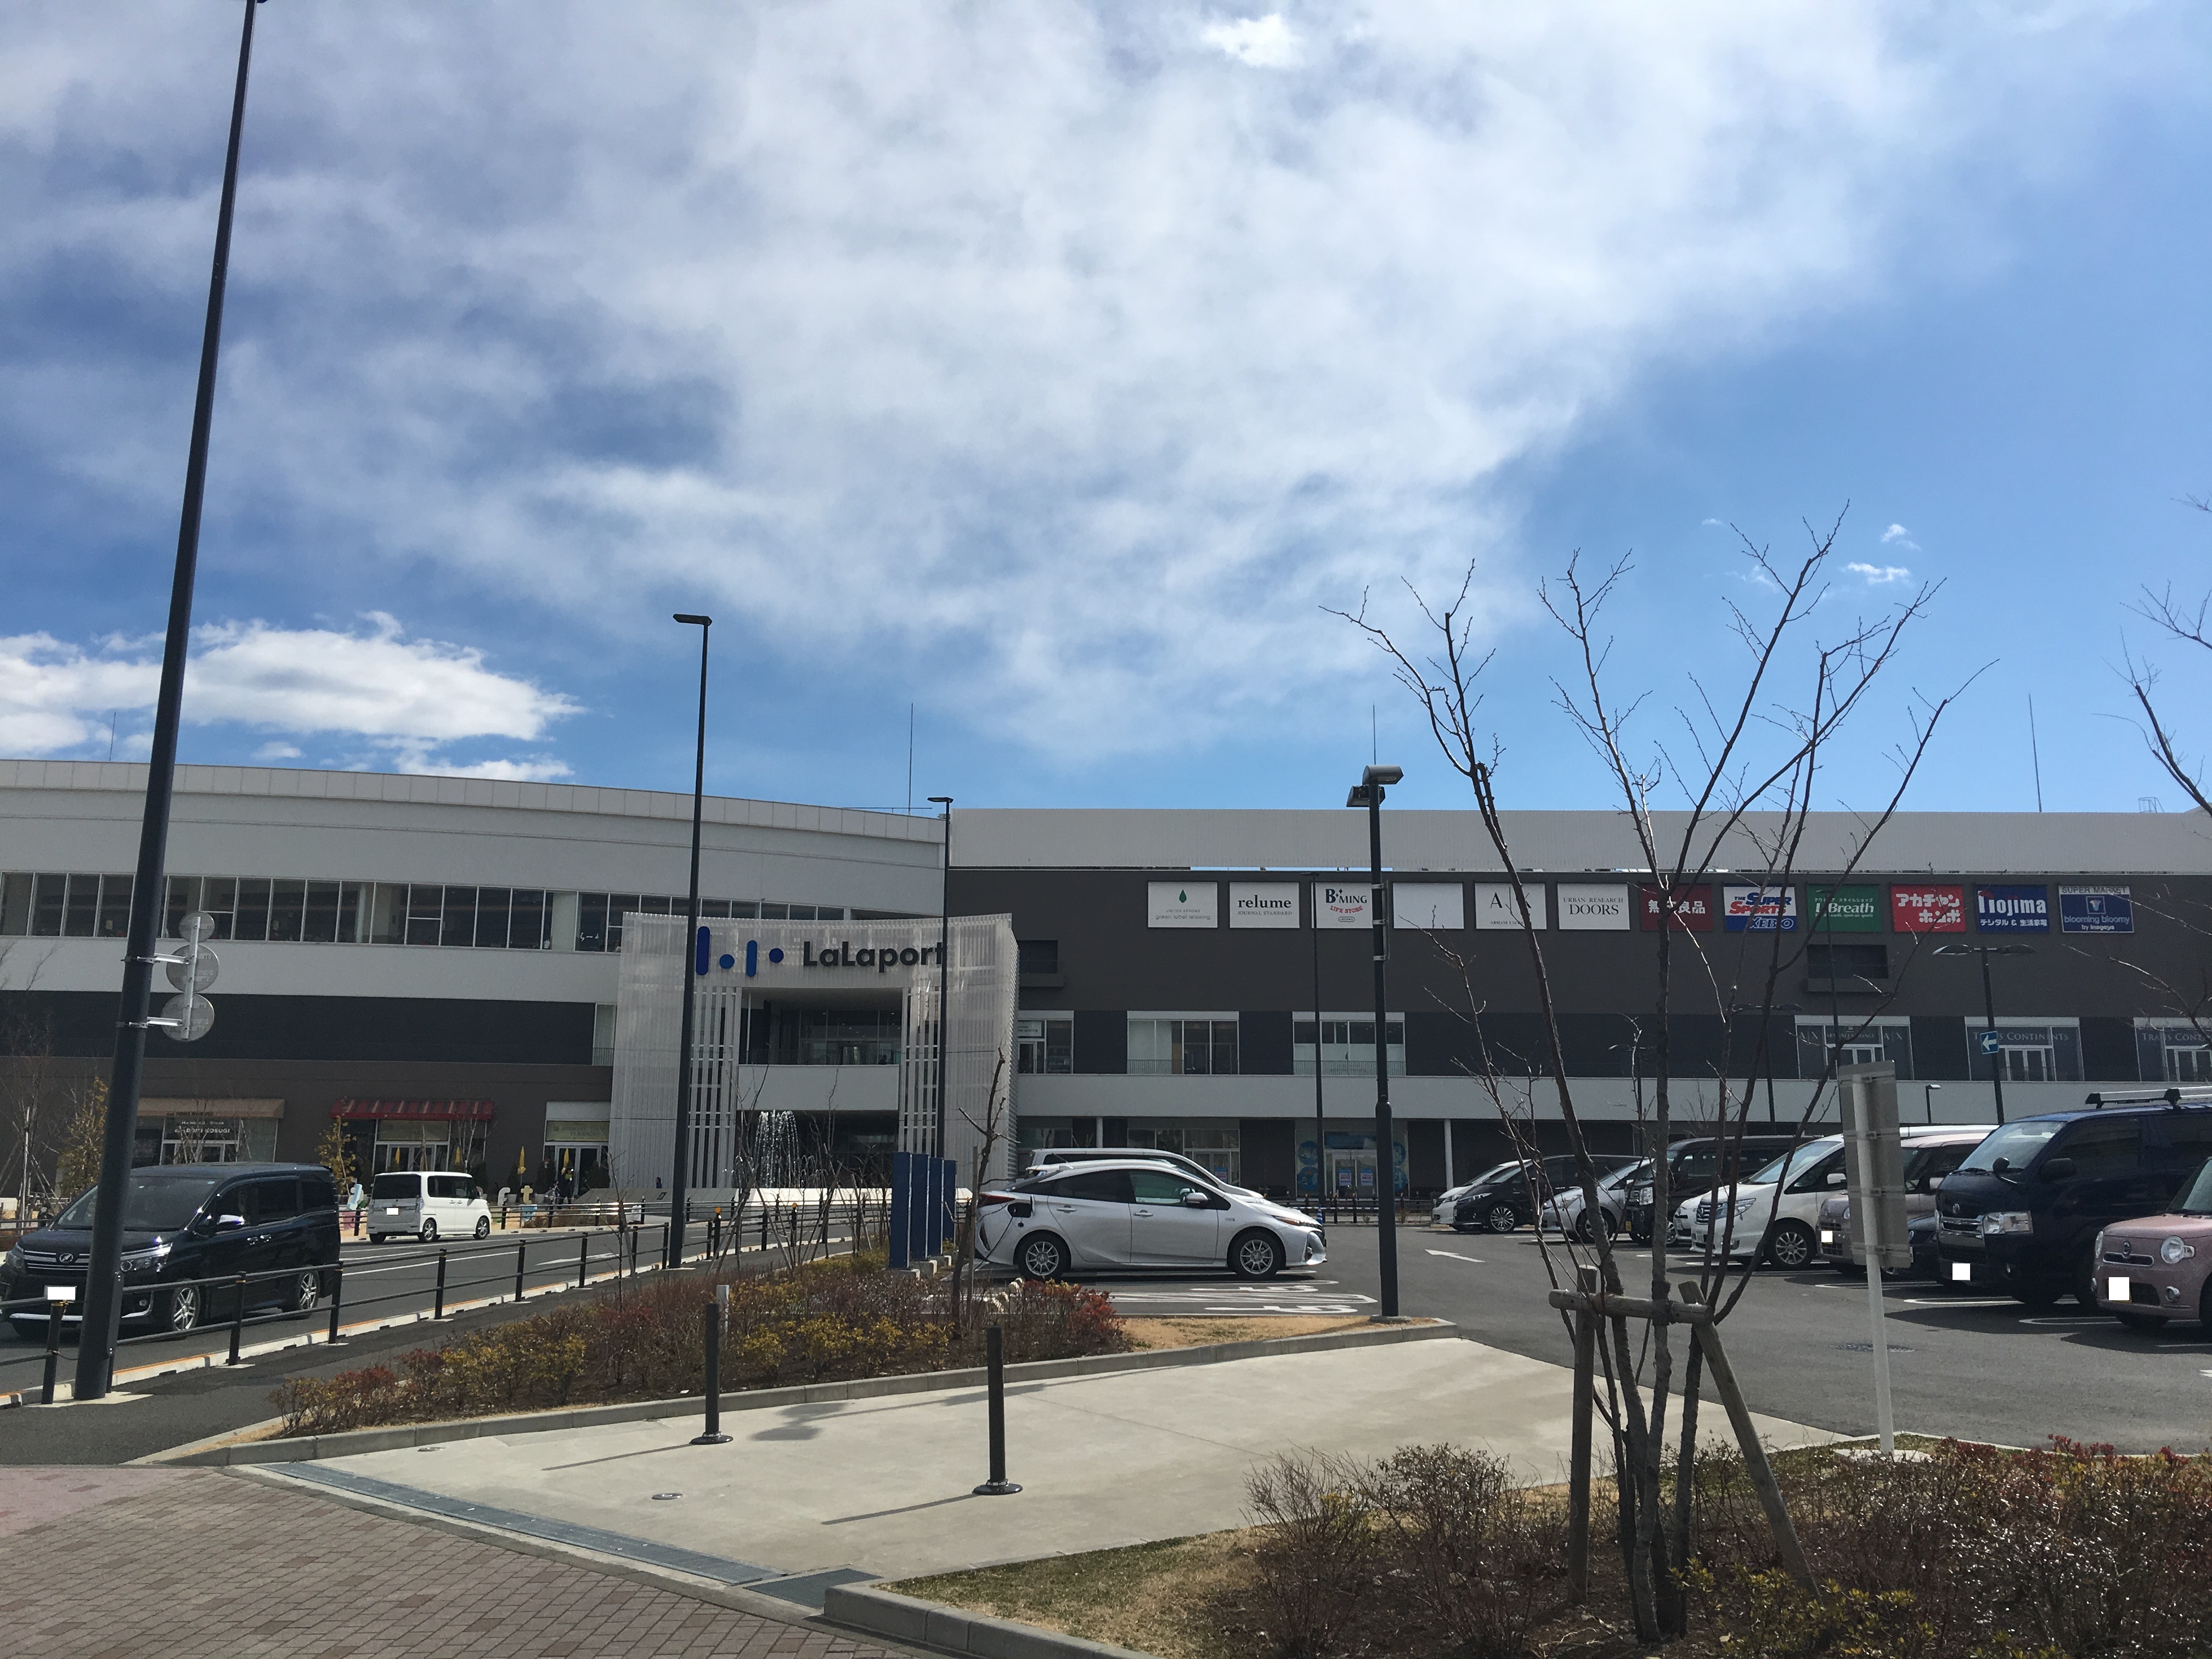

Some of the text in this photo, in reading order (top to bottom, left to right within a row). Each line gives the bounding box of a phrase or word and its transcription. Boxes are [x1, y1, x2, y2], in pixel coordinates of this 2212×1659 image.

[1238, 894, 1291, 908] relume
[1746, 892, 1792, 905] SUPER
[1896, 893, 1960, 907] アカチャン
[1570, 904, 1619, 915] DOORS
[1749, 917, 1794, 929] XEBO
[2064, 916, 2130, 924] blooming bloomy
[803, 941, 943, 973] LaLaport
[2006, 1032, 2069, 1041] CONTINNTS
